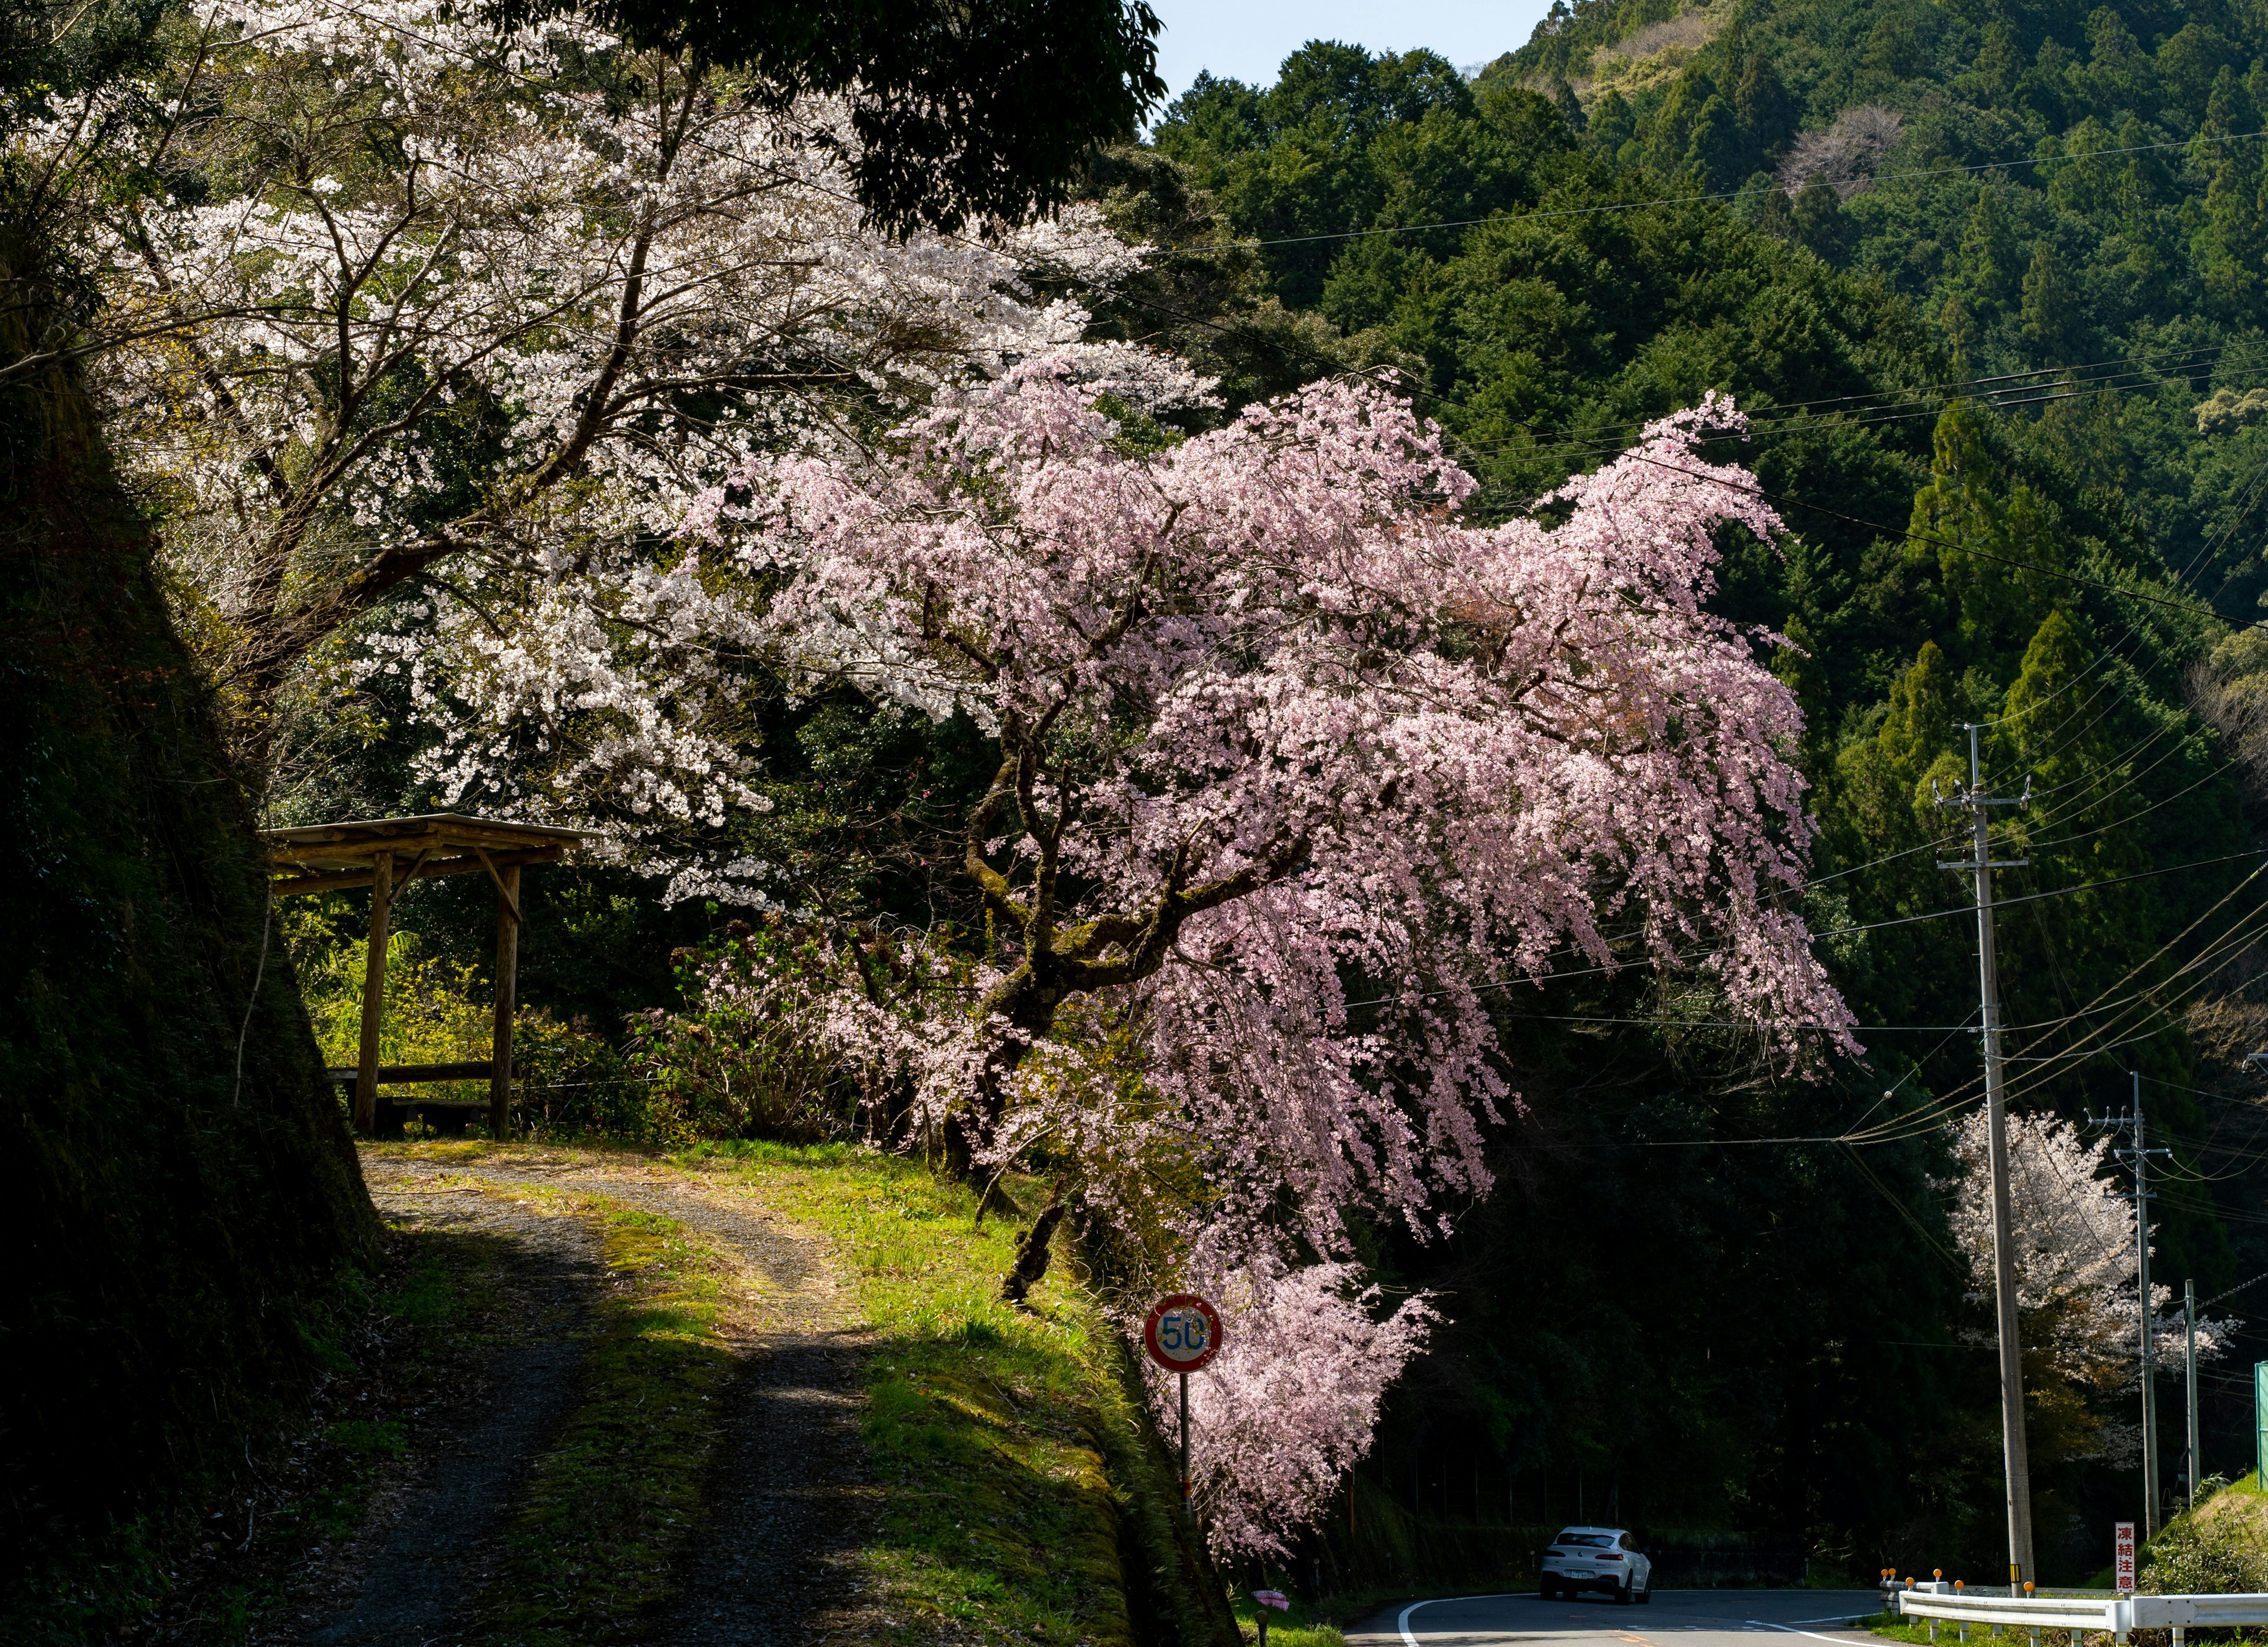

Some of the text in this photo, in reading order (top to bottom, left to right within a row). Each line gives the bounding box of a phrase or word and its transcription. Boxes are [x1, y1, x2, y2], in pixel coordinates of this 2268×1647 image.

[1163, 1317, 1204, 1350] 50
[2117, 1527, 2133, 1589] 凍結注意
